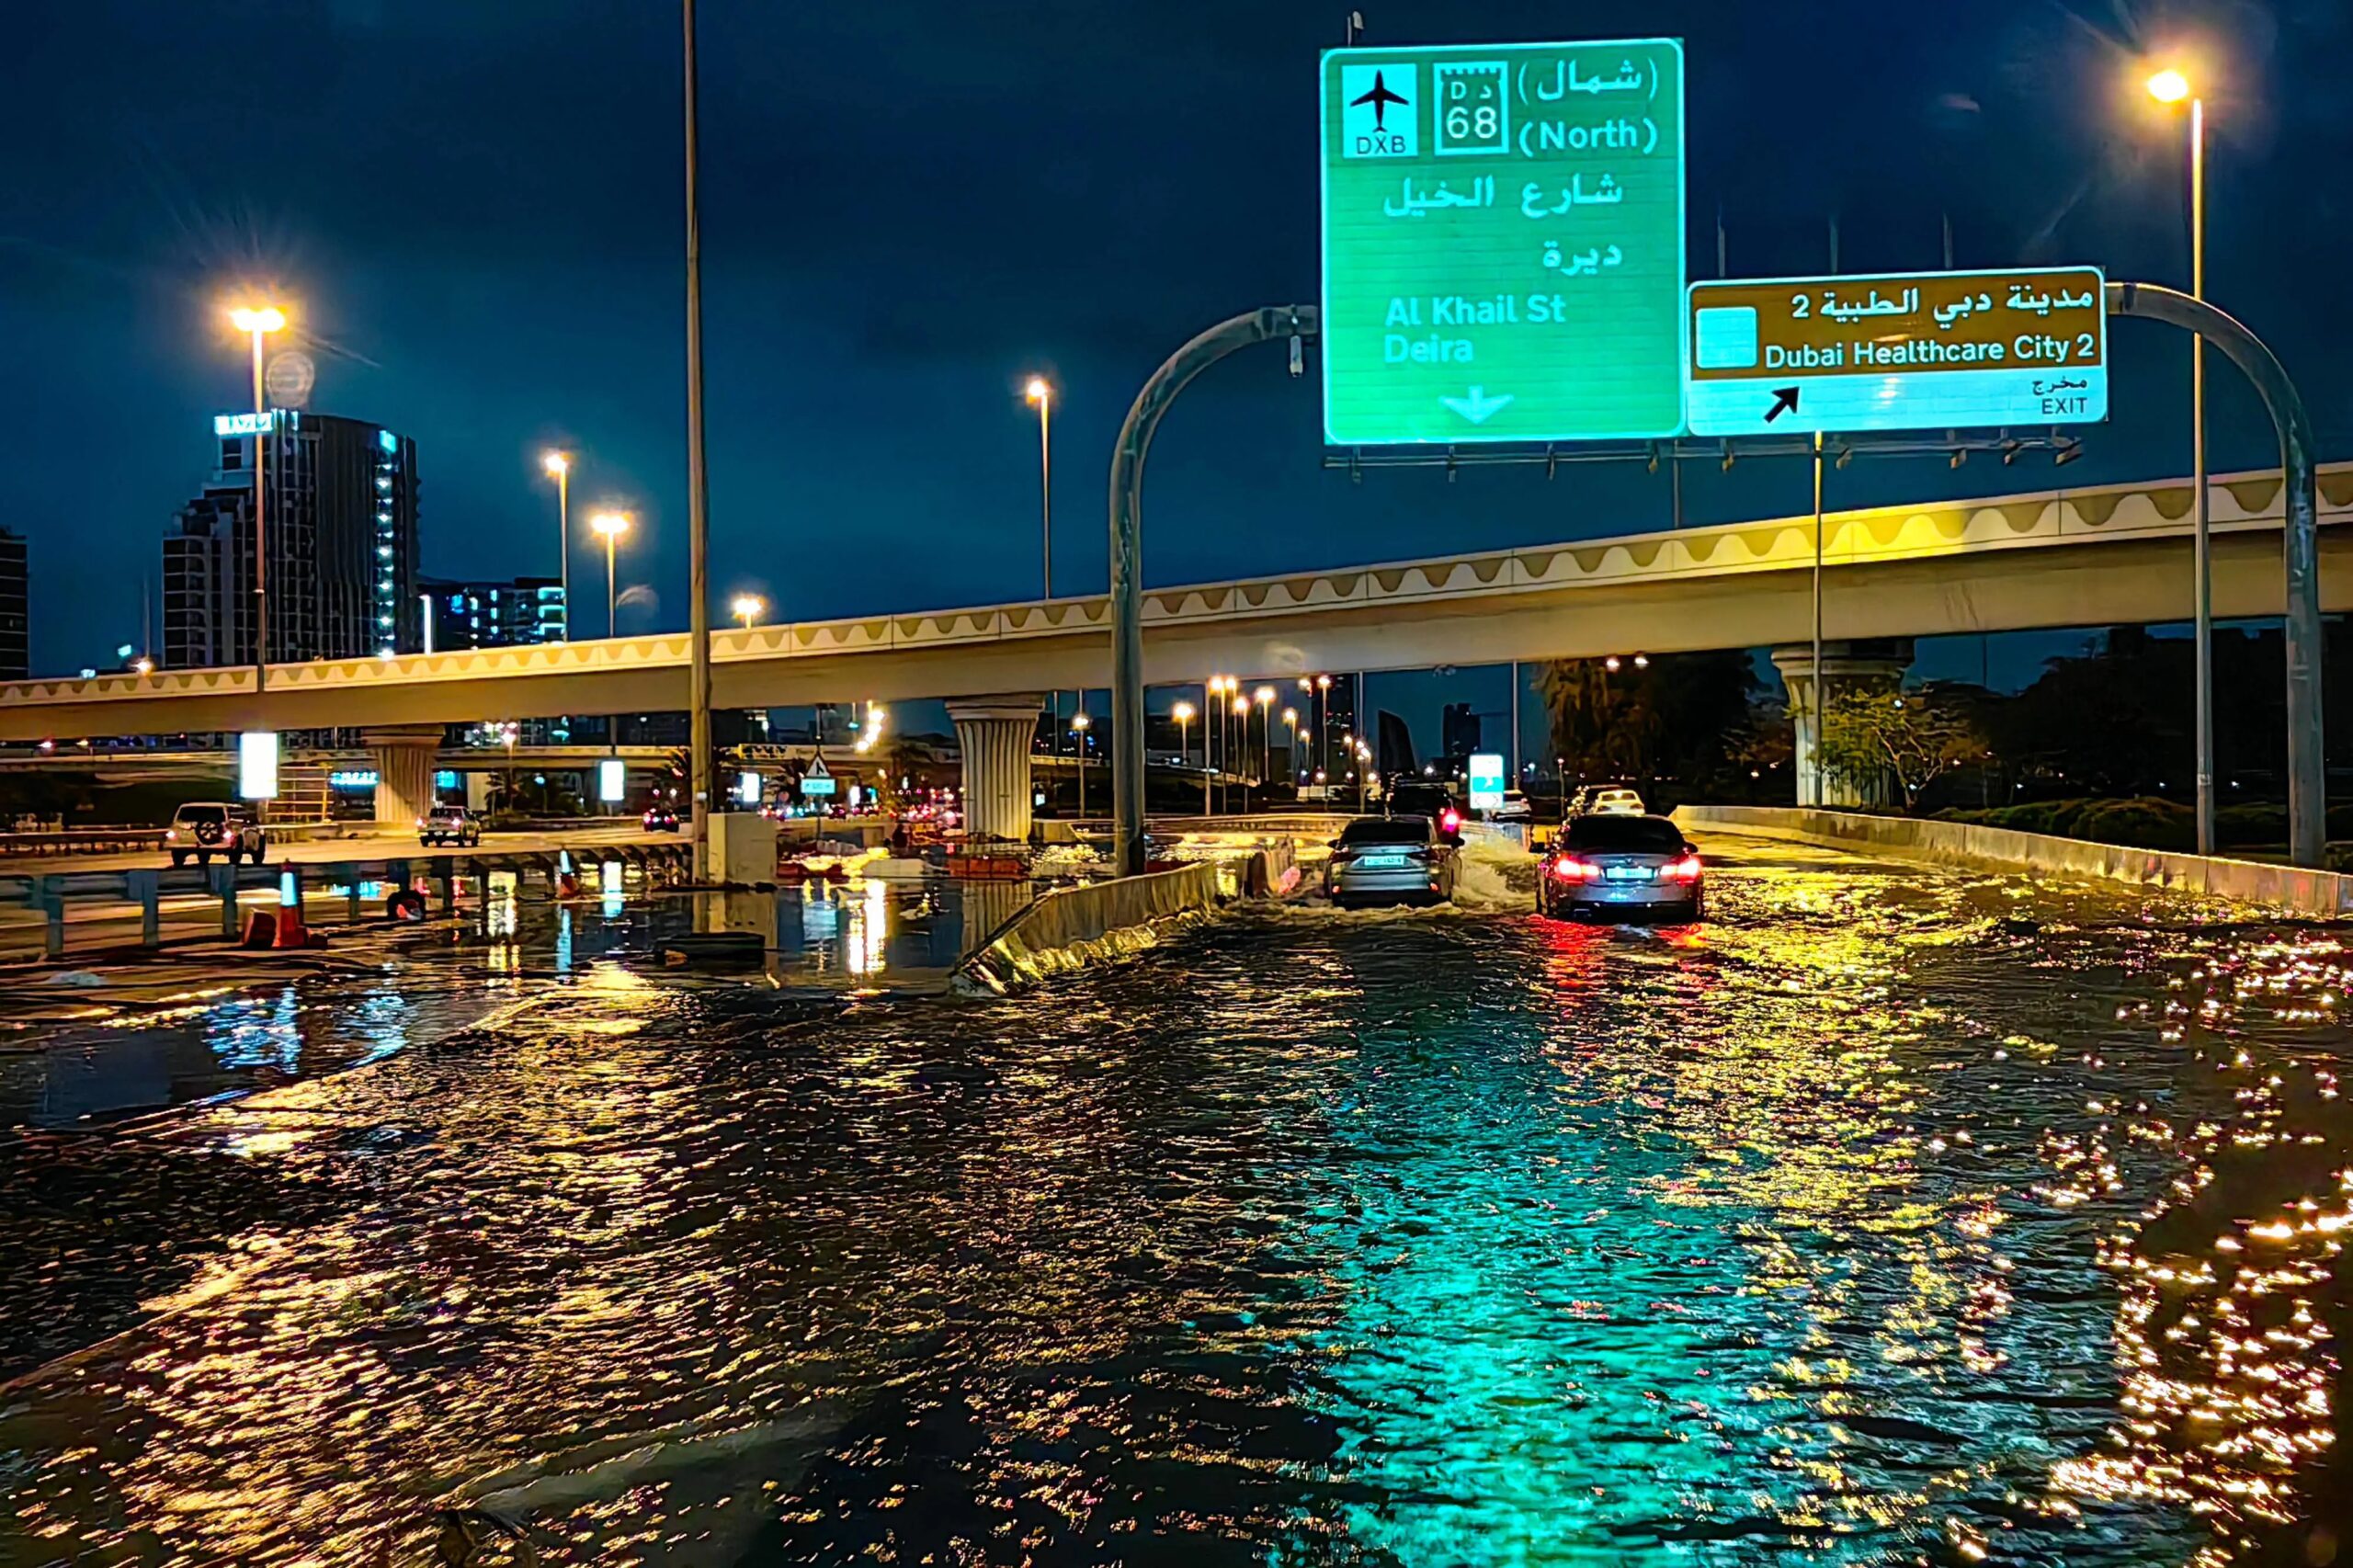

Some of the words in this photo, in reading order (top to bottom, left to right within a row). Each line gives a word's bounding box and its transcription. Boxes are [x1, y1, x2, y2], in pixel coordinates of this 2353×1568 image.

[1449, 81, 1466, 100] D
[1518, 57, 1658, 106] (شمال)
[1446, 106, 1497, 139] 68
[1518, 117, 1658, 157] (North)
[1356, 135, 1406, 155] DXB
[1382, 175, 1495, 218] الخيل
[1520, 173, 1623, 219] شارع
[1541, 239, 1623, 276] ديرة
[1384, 297, 1422, 327] Al
[1432, 294, 1518, 325] Khail
[1527, 293, 1567, 324] St
[1790, 294, 1811, 319] 2
[1819, 287, 1919, 324] الطبية
[1933, 290, 1993, 331] دبي
[2006, 282, 2094, 315] مدينة
[1383, 333, 1474, 364] Deira
[1765, 343, 1844, 369] Dubai
[1853, 334, 2005, 366] Healthcare
[2014, 335, 2070, 364] City
[2076, 334, 2095, 358] 2
[2030, 376, 2088, 395] مخرج
[2040, 396, 2087, 415] EXIT
